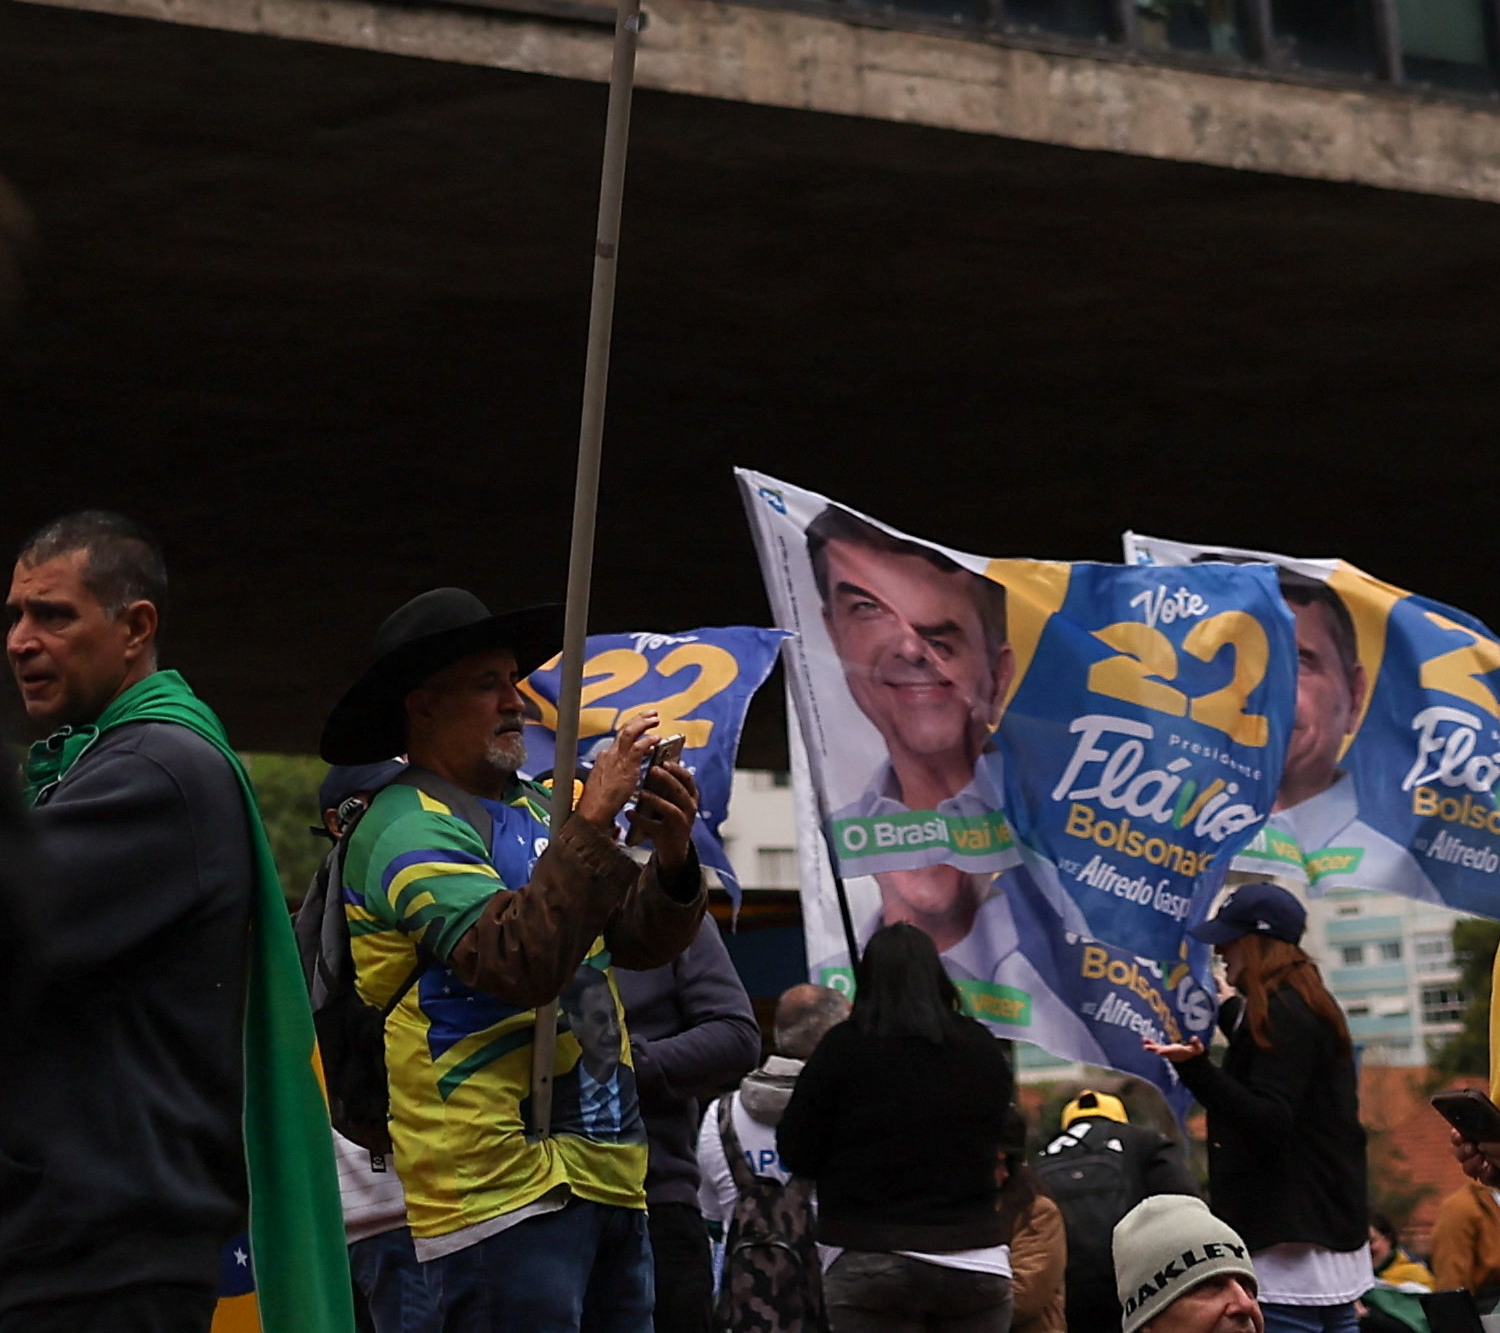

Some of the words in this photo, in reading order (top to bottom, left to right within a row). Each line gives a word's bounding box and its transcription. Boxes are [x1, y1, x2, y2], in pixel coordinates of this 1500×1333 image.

[1130, 585, 1209, 628] Vote
[562, 643, 739, 749] 22
[1087, 610, 1269, 747] 22
[1051, 715, 1264, 842] Flávio
[842, 824, 868, 852] O
[874, 818, 949, 848] Brasil
[952, 822, 992, 849] vai
[1426, 830, 1499, 874] Alfredo
[1076, 854, 1154, 906] Alfredo
[1125, 1242, 1245, 1318] OAKLEY
